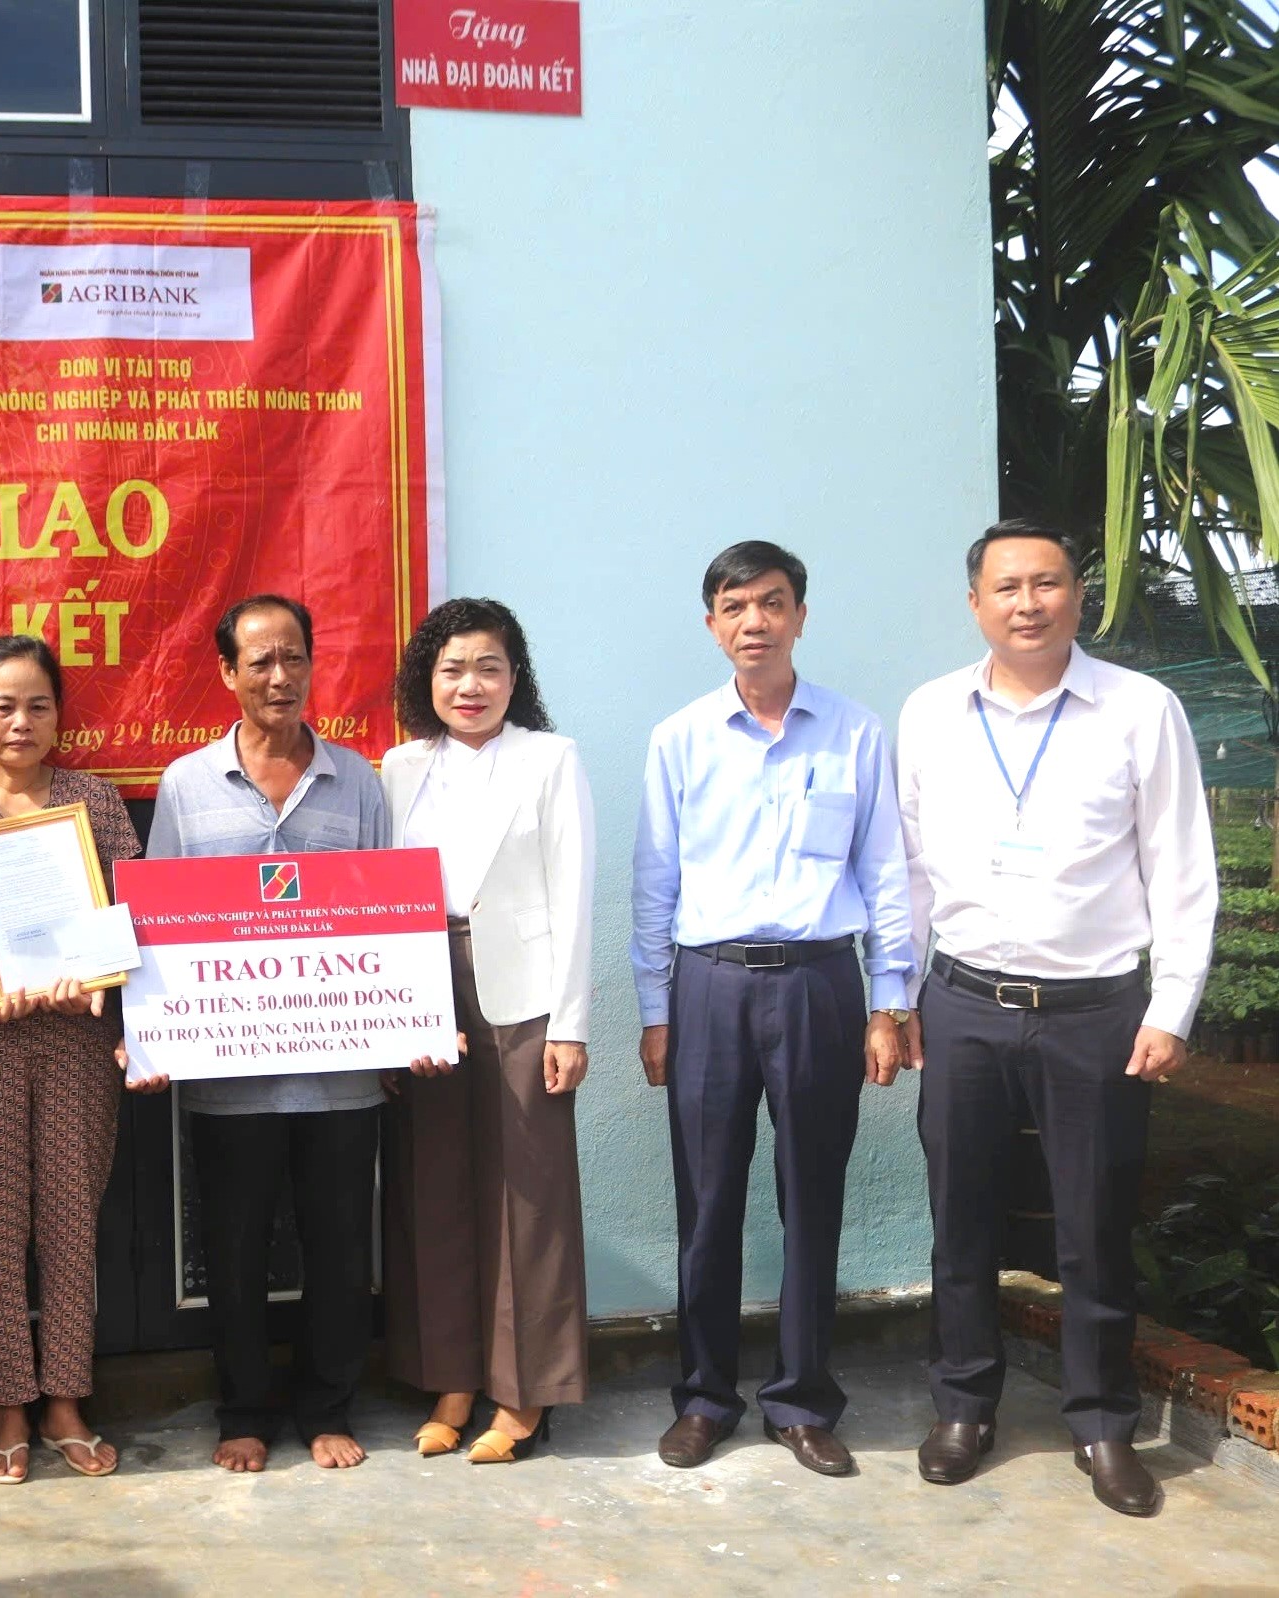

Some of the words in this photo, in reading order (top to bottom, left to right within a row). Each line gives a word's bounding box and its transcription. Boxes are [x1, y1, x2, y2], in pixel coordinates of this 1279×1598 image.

[448, 8, 526, 49] Tặng
[401, 53, 440, 86] NHÀ
[446, 60, 478, 91] ĐẠI
[483, 57, 533, 90] ĐOÀN
[539, 56, 574, 92] KẾT
[67, 284, 199, 304] AGRIBANK
[59, 357, 98, 378] ĐƠN
[103, 358, 121, 381] VỊ
[126, 355, 152, 378] TÀI
[158, 357, 192, 382] TRỢ
[53, 385, 122, 413] NGHIỆP
[128, 386, 150, 409] VÀ
[155, 387, 200, 410] PHÁT
[206, 382, 259, 410] TRIỂN
[265, 387, 310, 411] NÔNG
[315, 388, 362, 411] THÔN
[36, 422, 68, 442] CHI
[75, 417, 138, 441] NHÁNH
[143, 415, 179, 441] ĐẮK
[185, 415, 219, 440] LẮK
[151, 719, 223, 744] tháng
[317, 715, 369, 739] 2024
[132, 914, 155, 926] GÂN
[157, 913, 185, 925] HÀNG
[187, 911, 216, 923] NÔNG
[217, 910, 254, 923] NGHIỆP
[256, 909, 269, 920] VÀ
[271, 907, 297, 919] PHÁT
[300, 906, 328, 918] TRIỂN
[330, 906, 359, 916] NÔNG
[361, 903, 387, 915] THÔN
[389, 902, 412, 915] VIỆT
[413, 903, 436, 913] NAM
[233, 926, 251, 936] CHI
[254, 923, 288, 935] NHÁNH
[190, 957, 282, 983] TRAO
[290, 951, 381, 983] TẶNG
[163, 994, 190, 1016] SỐ
[195, 992, 251, 1014] TIỀN:
[257, 990, 348, 1011] 50.000.000
[353, 984, 413, 1007] ĐỒNG
[165, 1025, 200, 1043] TRỢ
[204, 1022, 241, 1040] XÂY
[242, 1022, 287, 1039] DỰNG
[292, 1017, 326, 1034] NHÀ
[330, 1018, 358, 1035] ĐẠI
[362, 1013, 407, 1031] ĐOÀN
[412, 1010, 443, 1028] KẾT
[215, 1041, 271, 1059] HUYỆN
[276, 1036, 334, 1054] KRÔNG
[337, 1037, 370, 1051] ANA
